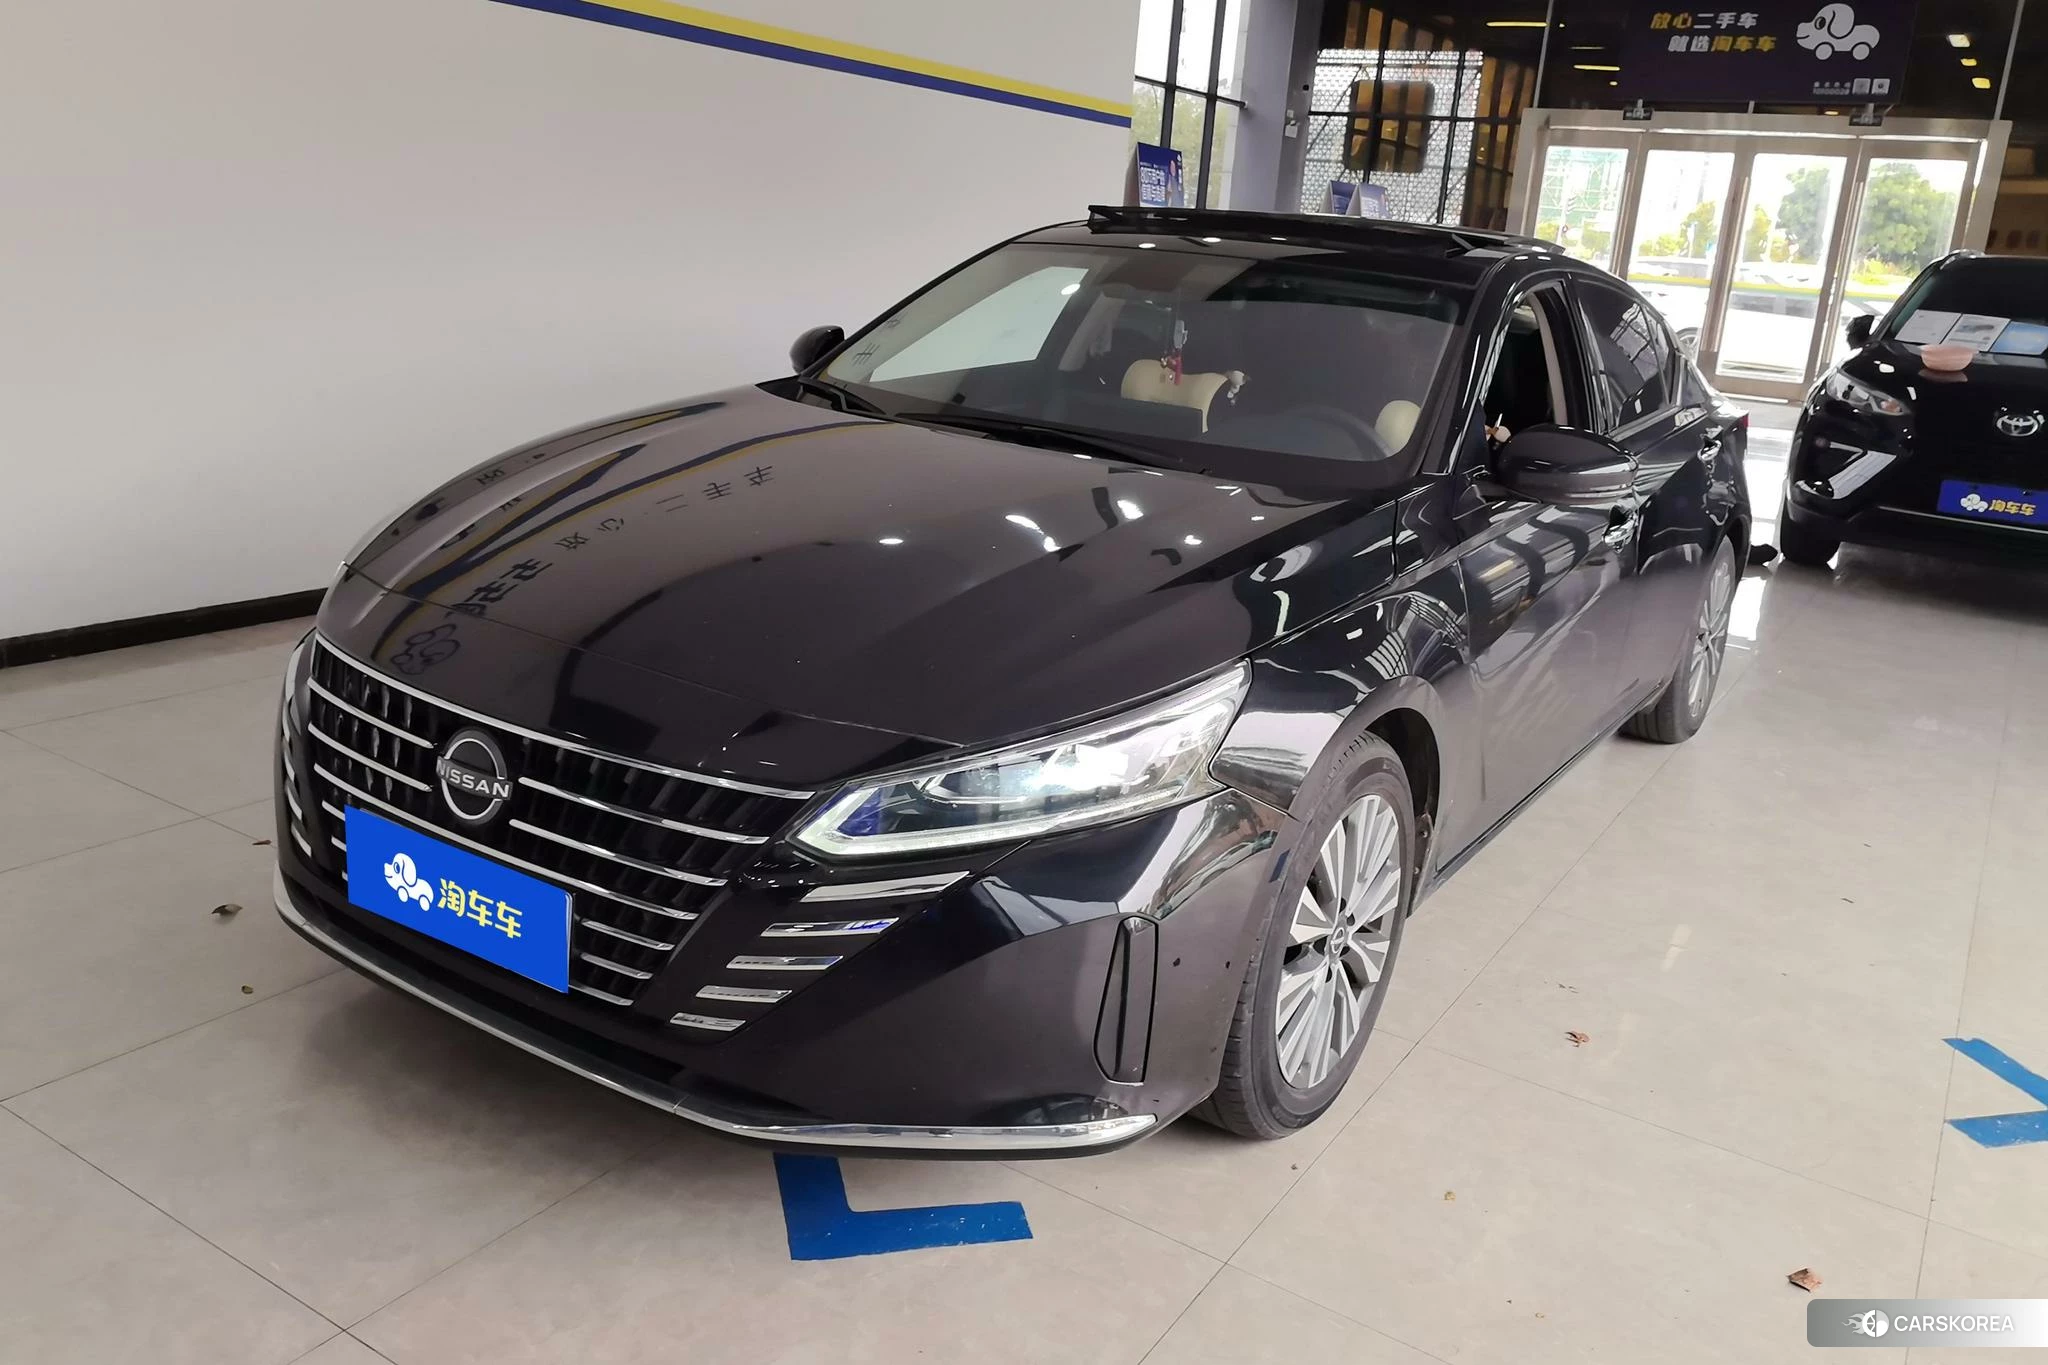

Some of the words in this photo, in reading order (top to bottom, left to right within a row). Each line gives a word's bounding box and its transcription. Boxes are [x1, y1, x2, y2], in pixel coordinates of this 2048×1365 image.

[1650, 12, 1759, 29] 放心二手车
[436, 756, 510, 798] NISSAN
[437, 878, 523, 939] 淘车车
